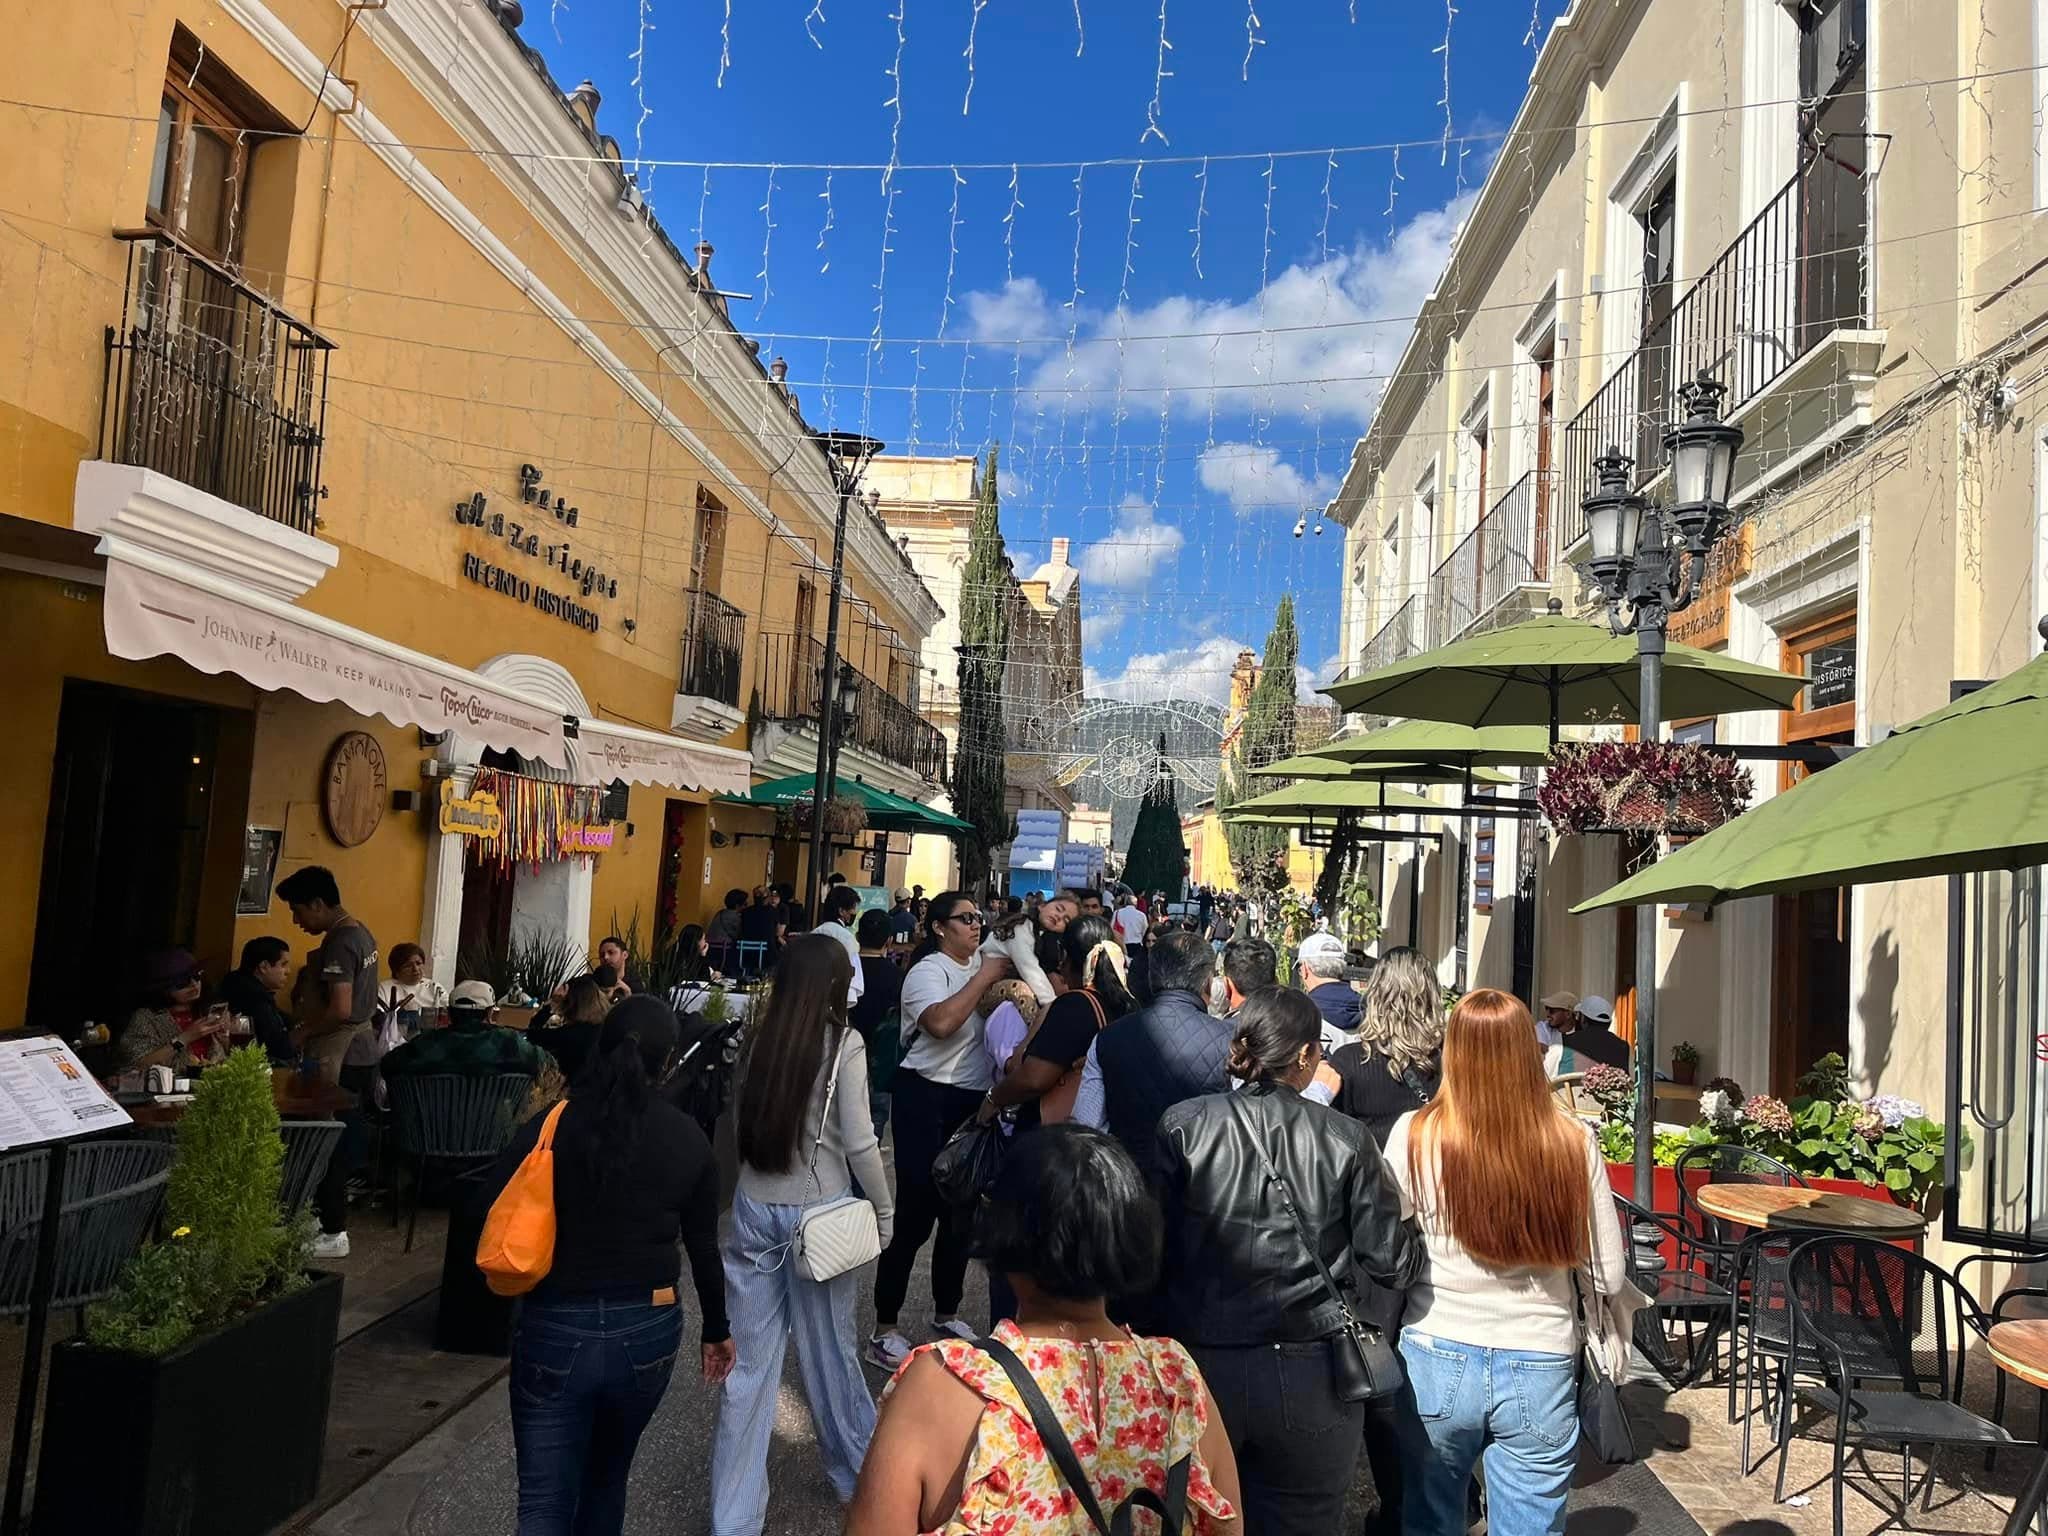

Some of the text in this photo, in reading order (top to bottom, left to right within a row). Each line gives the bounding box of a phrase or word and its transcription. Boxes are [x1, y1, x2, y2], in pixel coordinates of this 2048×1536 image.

[464, 552, 599, 632] RECINTO HISTÓRICO
[279, 641, 329, 672] WALKER
[335, 664, 364, 682] KEEP
[368, 674, 412, 699] WALKING
